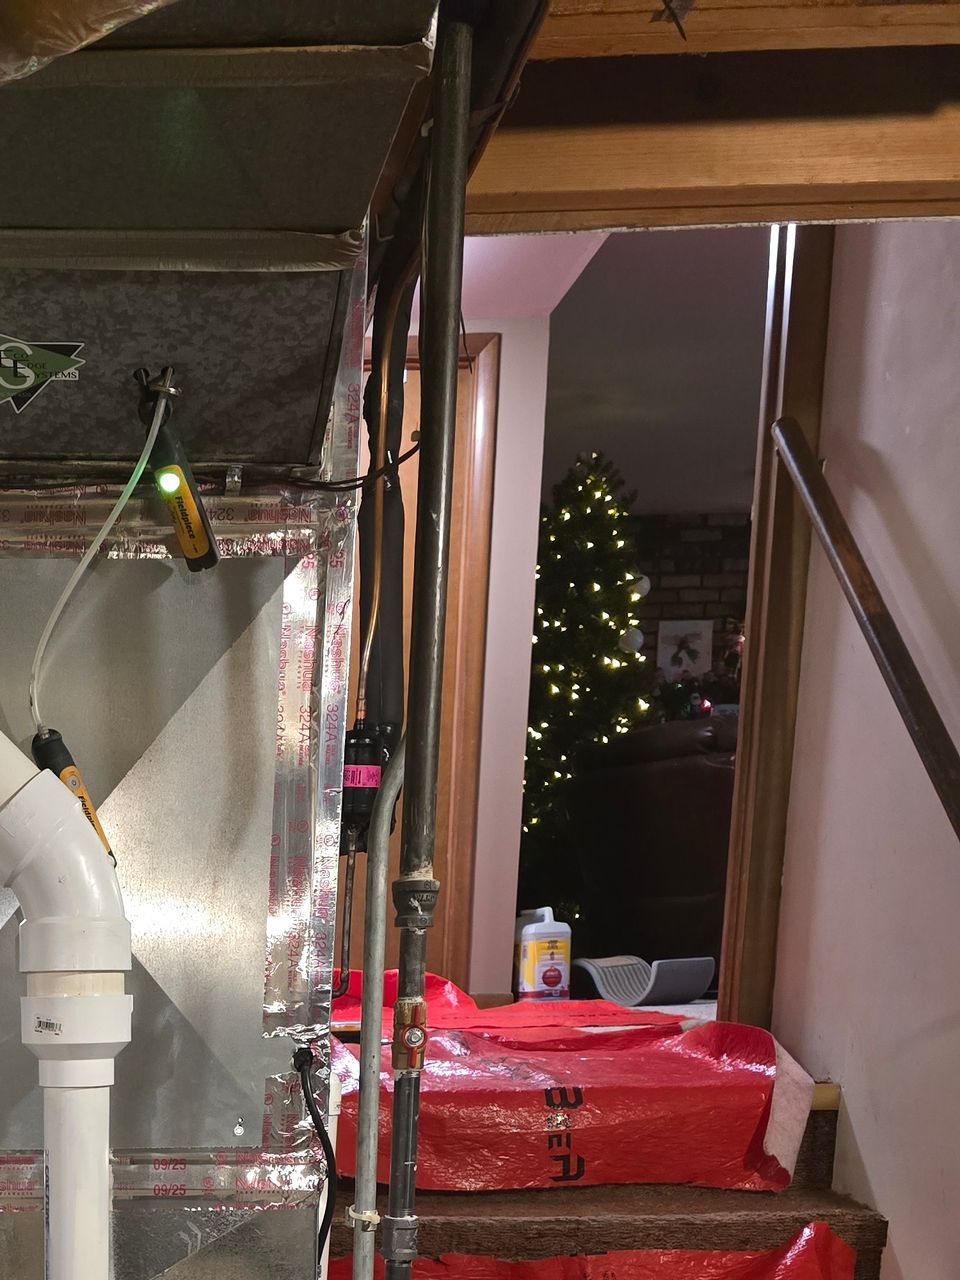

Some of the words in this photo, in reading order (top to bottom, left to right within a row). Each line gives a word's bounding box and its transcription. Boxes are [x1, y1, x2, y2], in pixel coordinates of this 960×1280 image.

[21, 510, 86, 525] Nashua
[175, 495, 195, 539] Fieldpiece
[302, 624, 320, 693] Nashua
[298, 704, 312, 744] 324A
[325, 704, 340, 744] 324A
[152, 1158, 187, 1171] 09/25
[152, 1183, 187, 1197] 09/25
